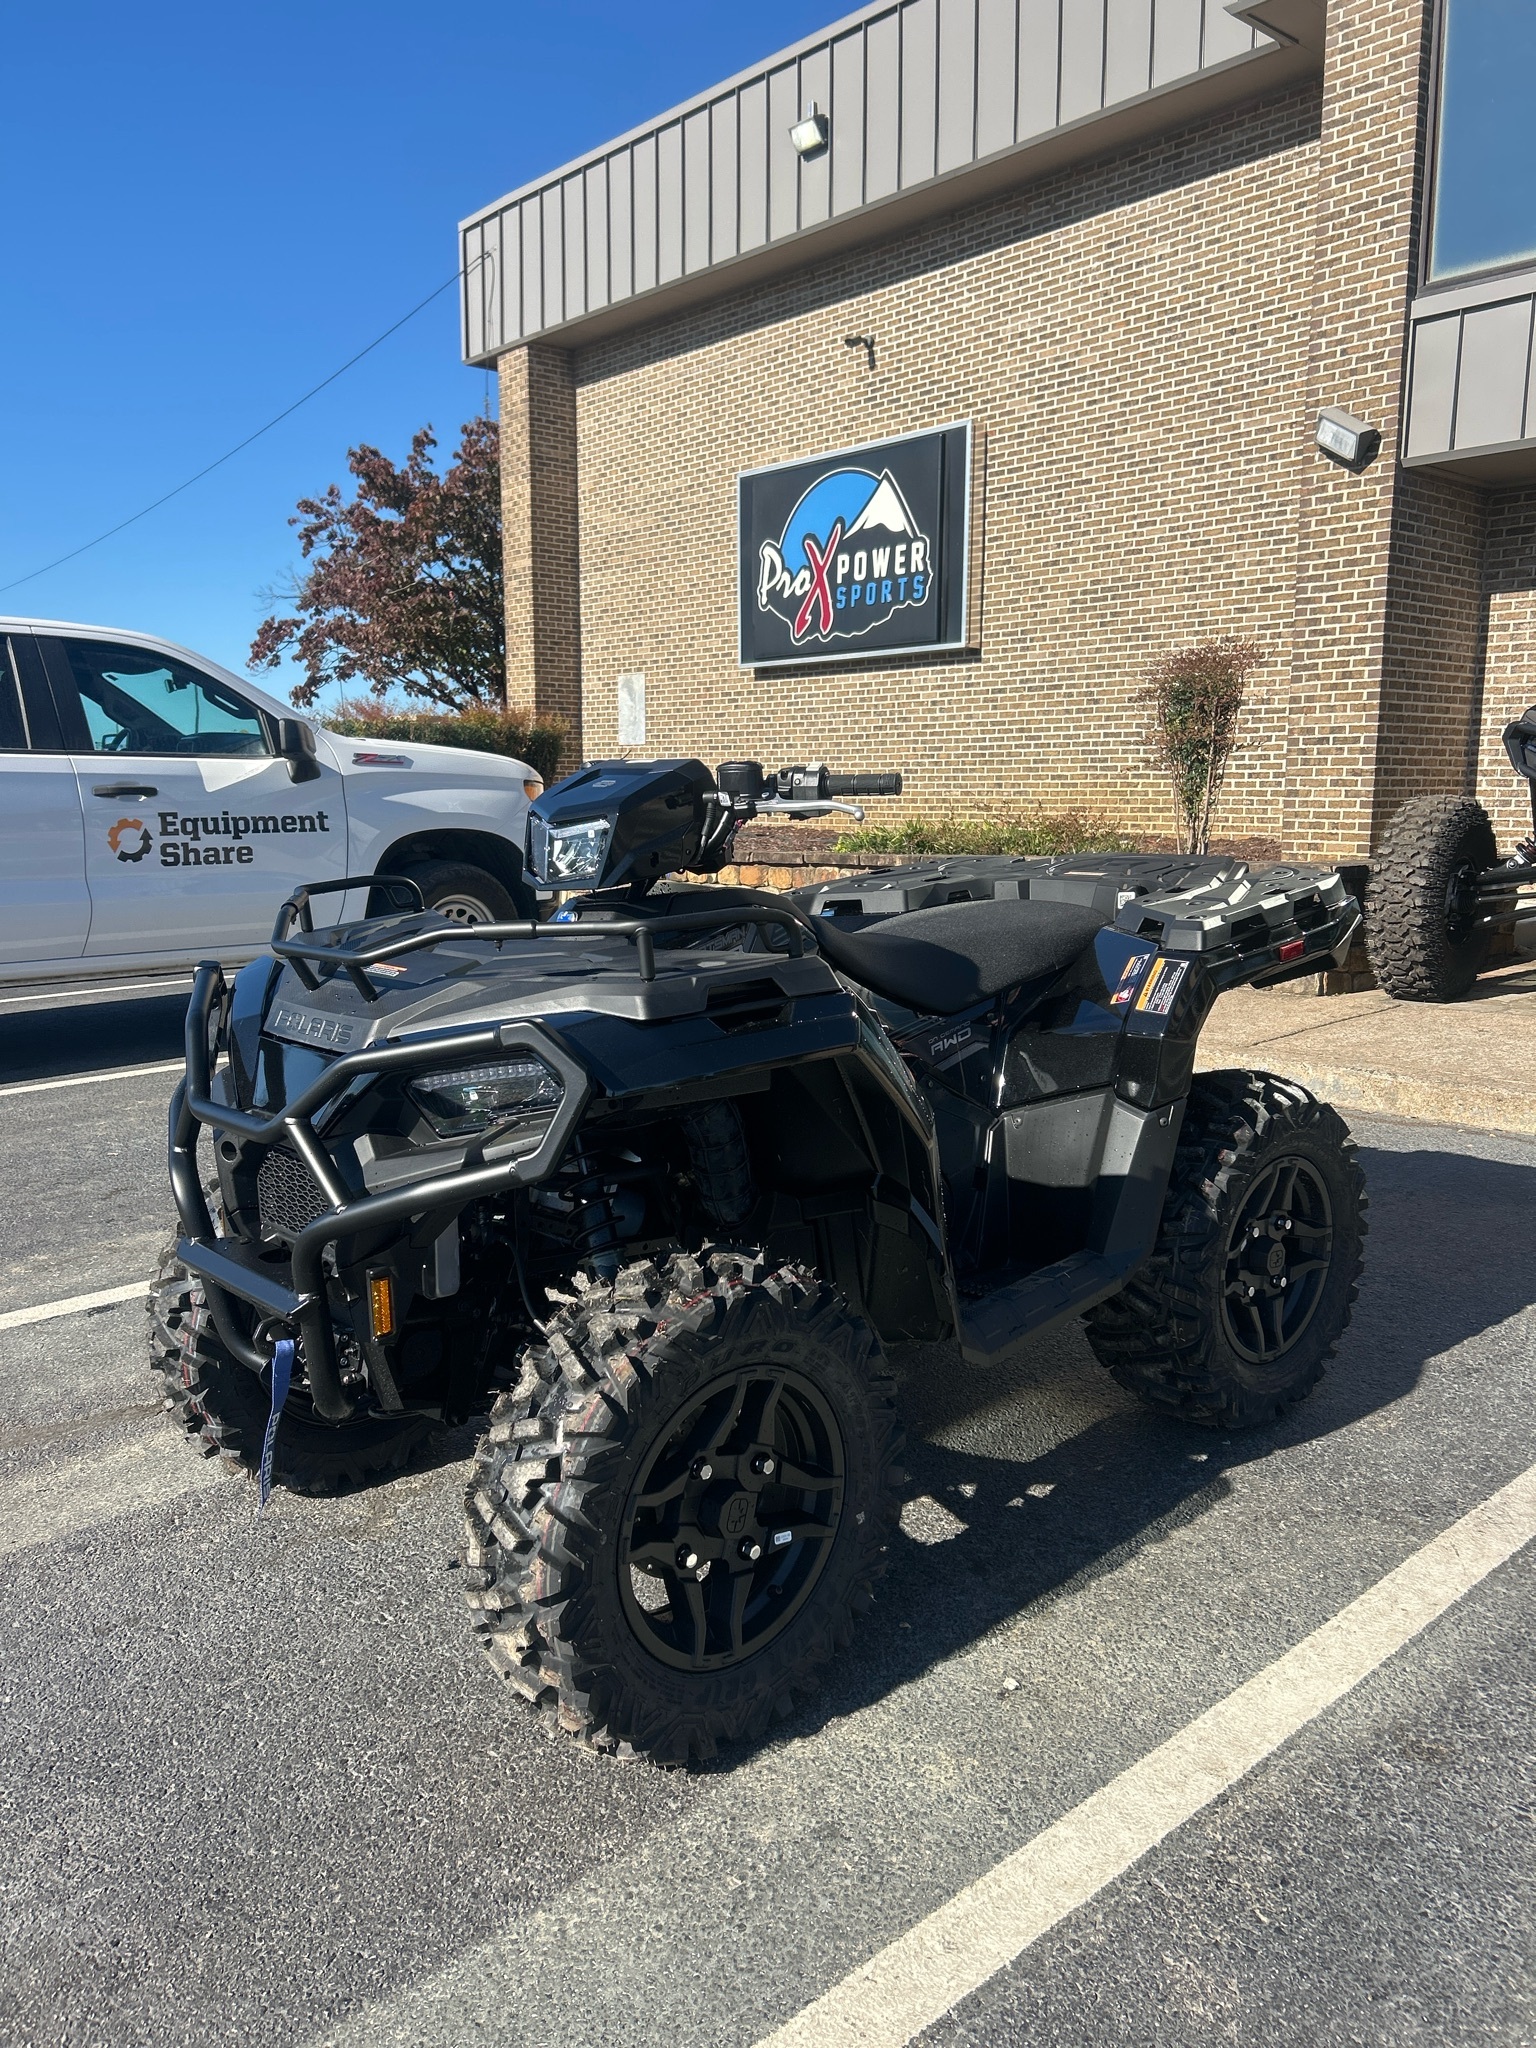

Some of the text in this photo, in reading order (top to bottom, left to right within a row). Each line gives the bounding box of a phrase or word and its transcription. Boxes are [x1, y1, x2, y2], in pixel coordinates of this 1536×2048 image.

[836, 541, 925, 584] POWER
[836, 575, 925, 609] SPORTS
[158, 811, 330, 841] Equipment
[160, 842, 254, 867] Share
[274, 1009, 354, 1045] POLARIS
[930, 1027, 972, 1056] AWD
[263, 1411, 281, 1500] POLARIS
